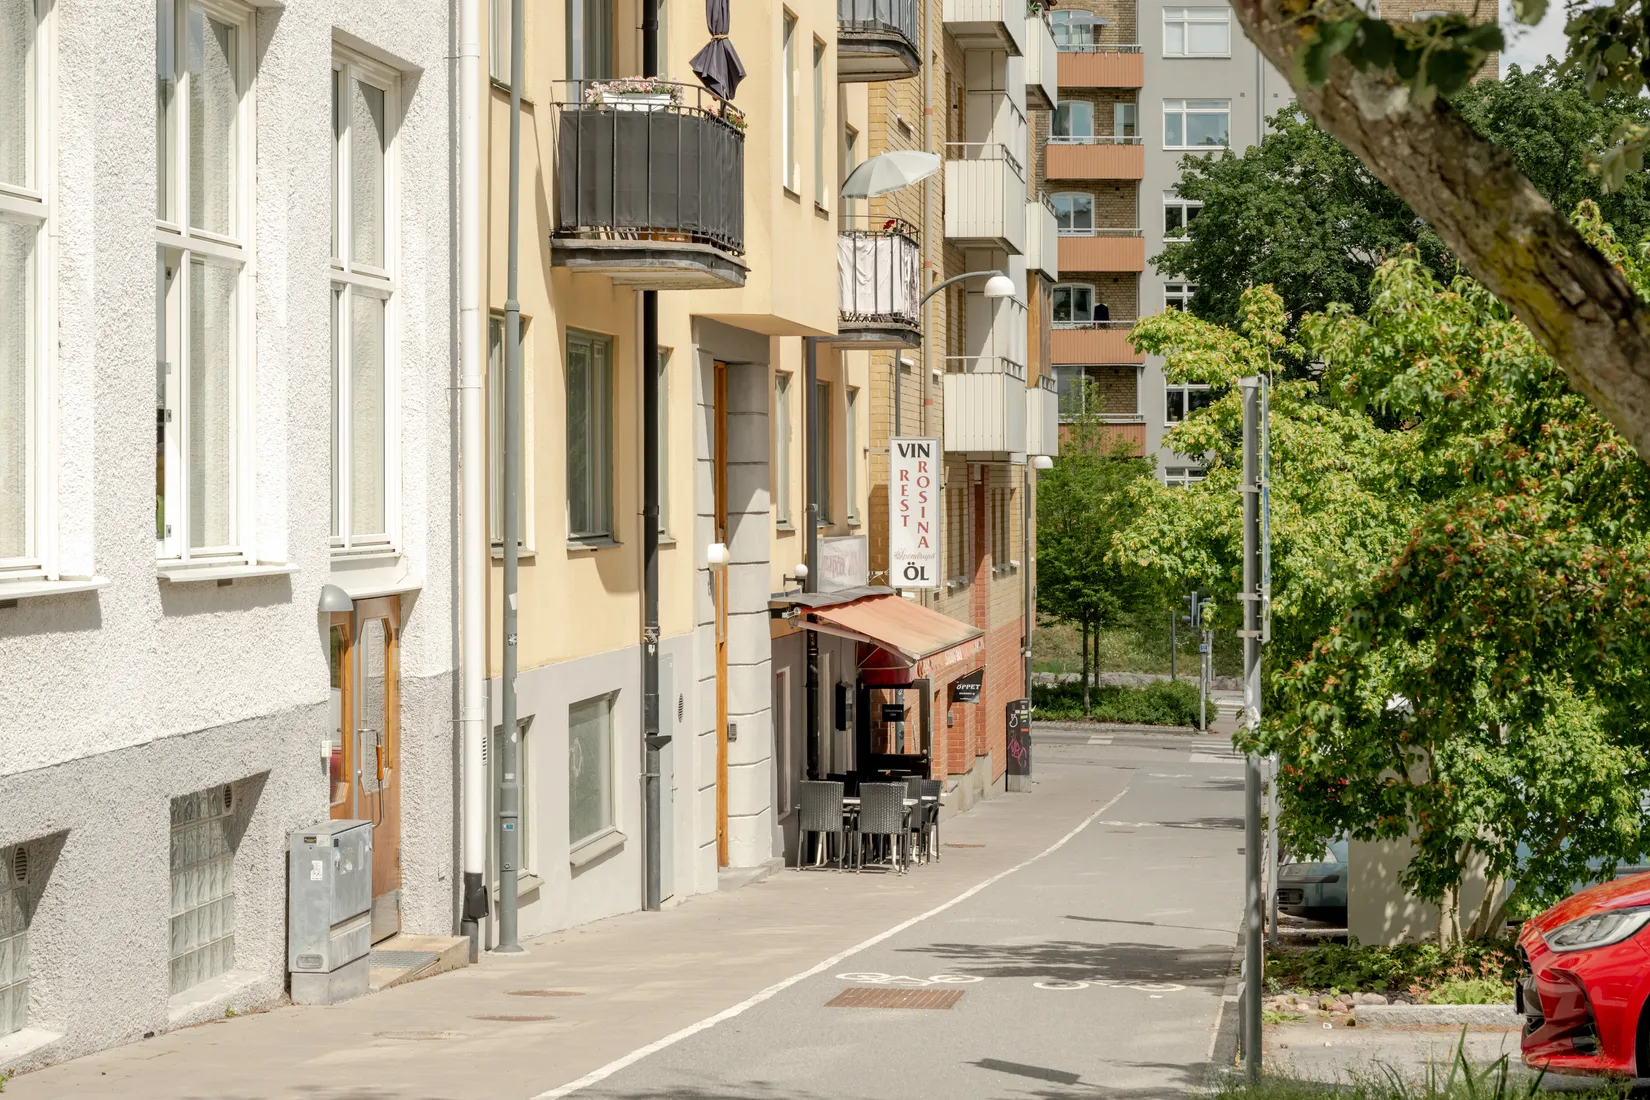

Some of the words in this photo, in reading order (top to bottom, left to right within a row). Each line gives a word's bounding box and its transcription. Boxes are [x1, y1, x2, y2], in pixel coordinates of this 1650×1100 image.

[897, 443, 931, 458] VIN
[899, 469, 910, 527] REST
[916, 460, 930, 548] ROSINA
[903, 561, 930, 581] ÖL
